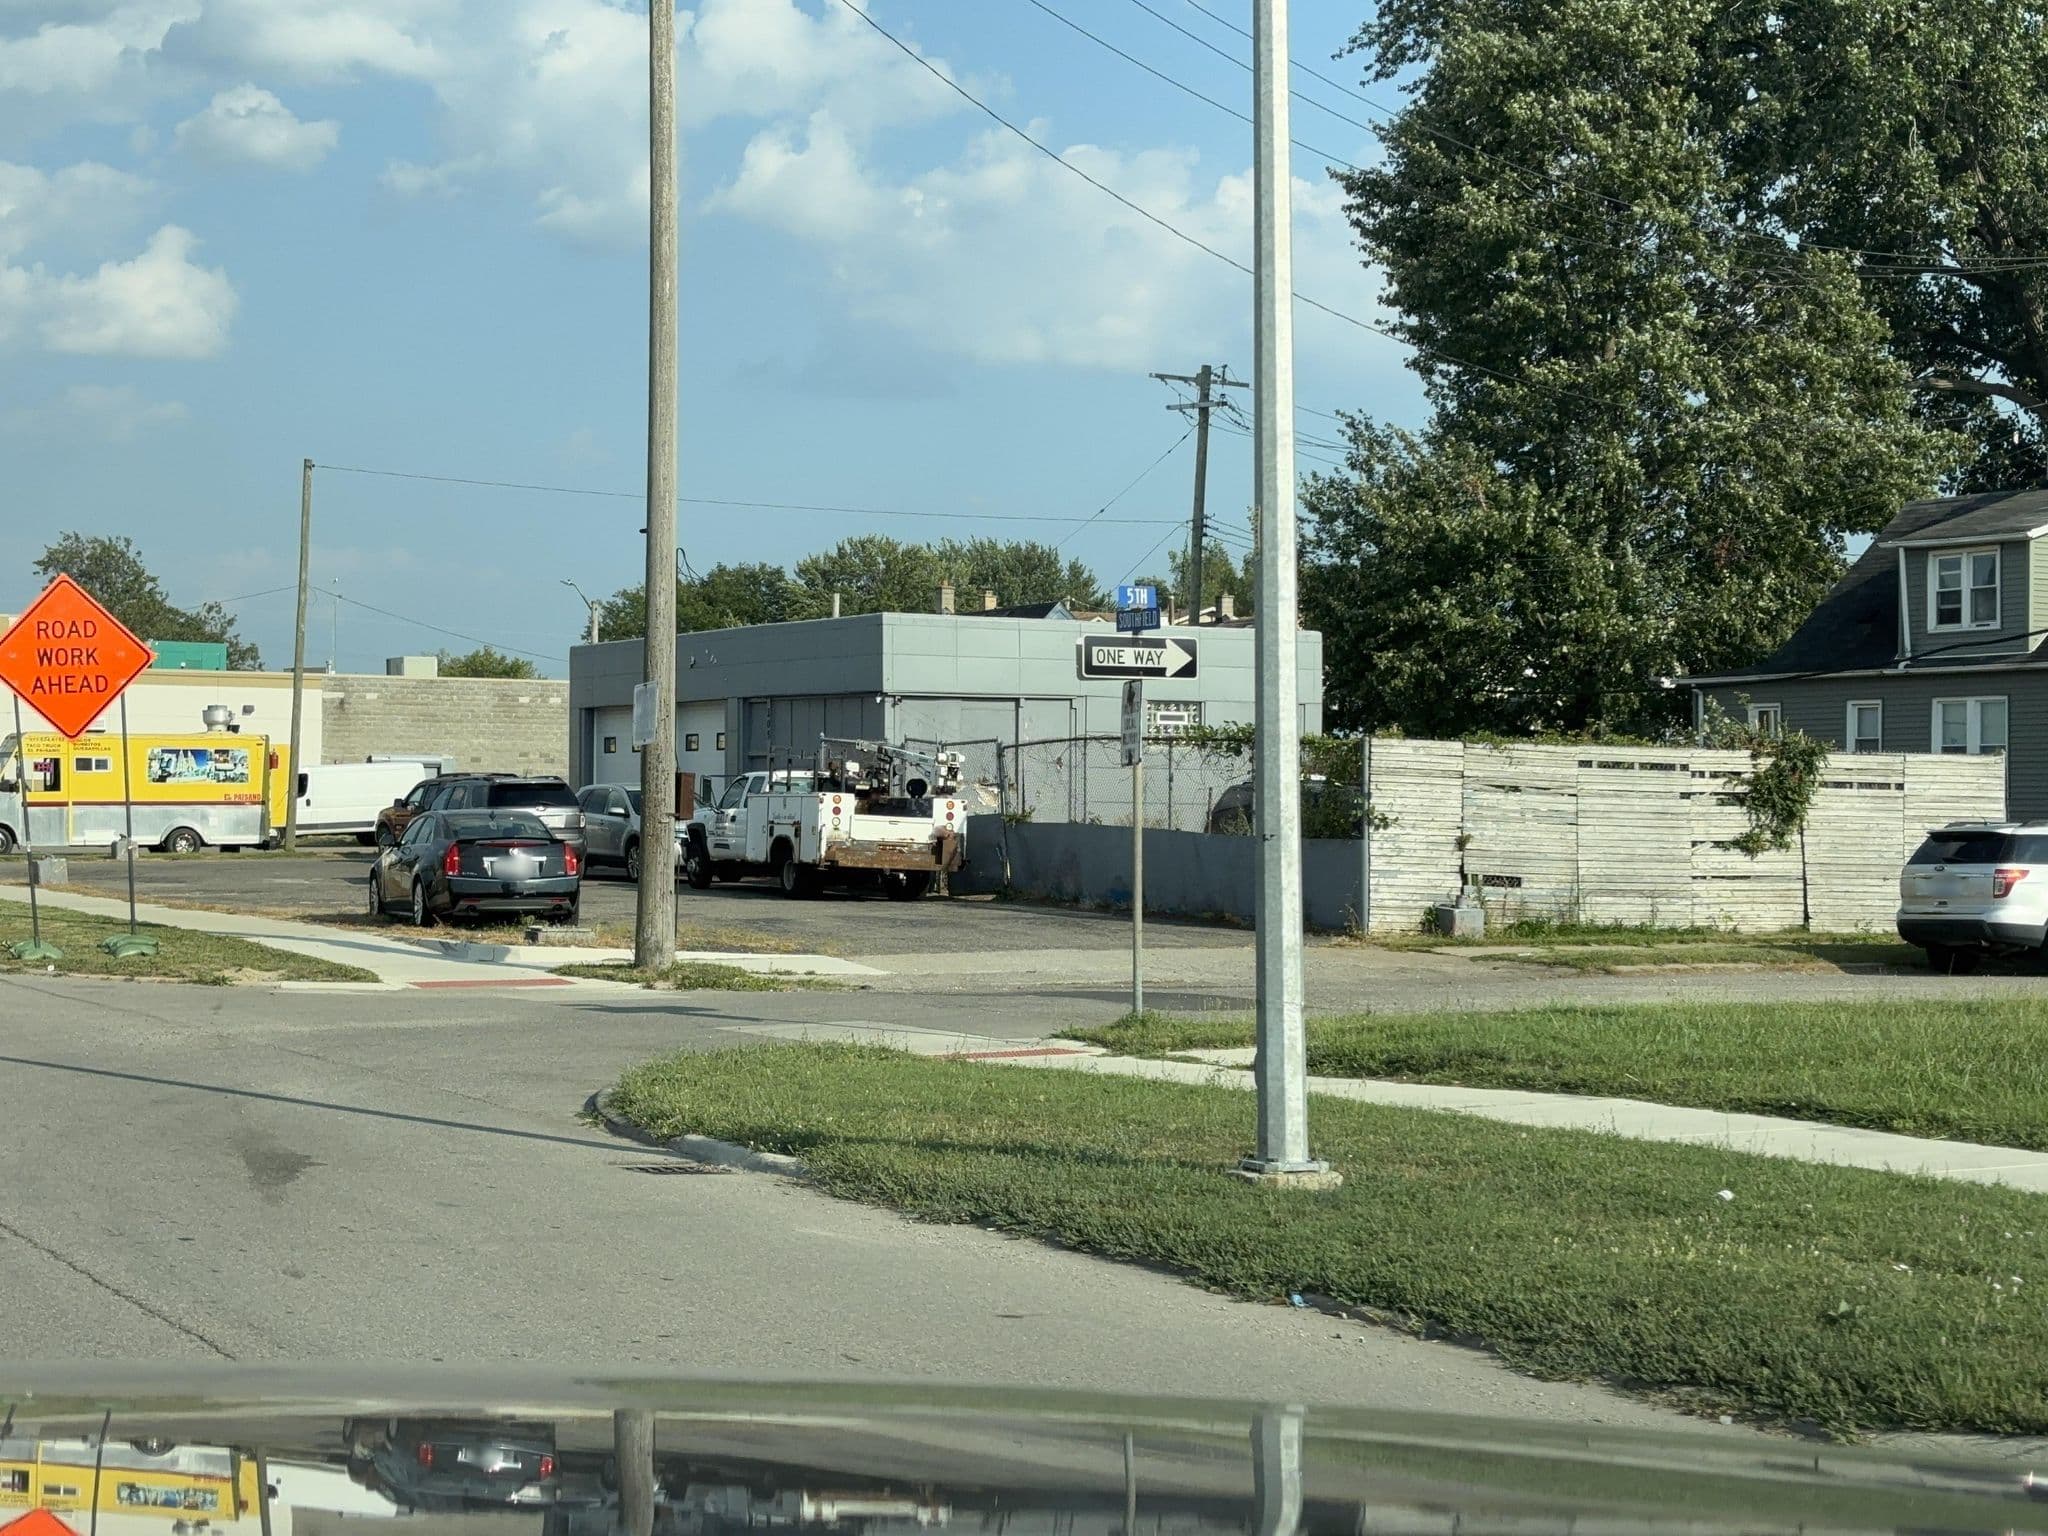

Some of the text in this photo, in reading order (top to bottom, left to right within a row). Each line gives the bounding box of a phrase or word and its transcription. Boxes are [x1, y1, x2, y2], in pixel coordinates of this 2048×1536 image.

[1127, 588, 1148, 604] 5TH
[36, 620, 97, 639] ROAD
[37, 648, 99, 667] WORK
[1096, 649, 1163, 665] ONE WAY
[31, 675, 108, 695] AHEAD
